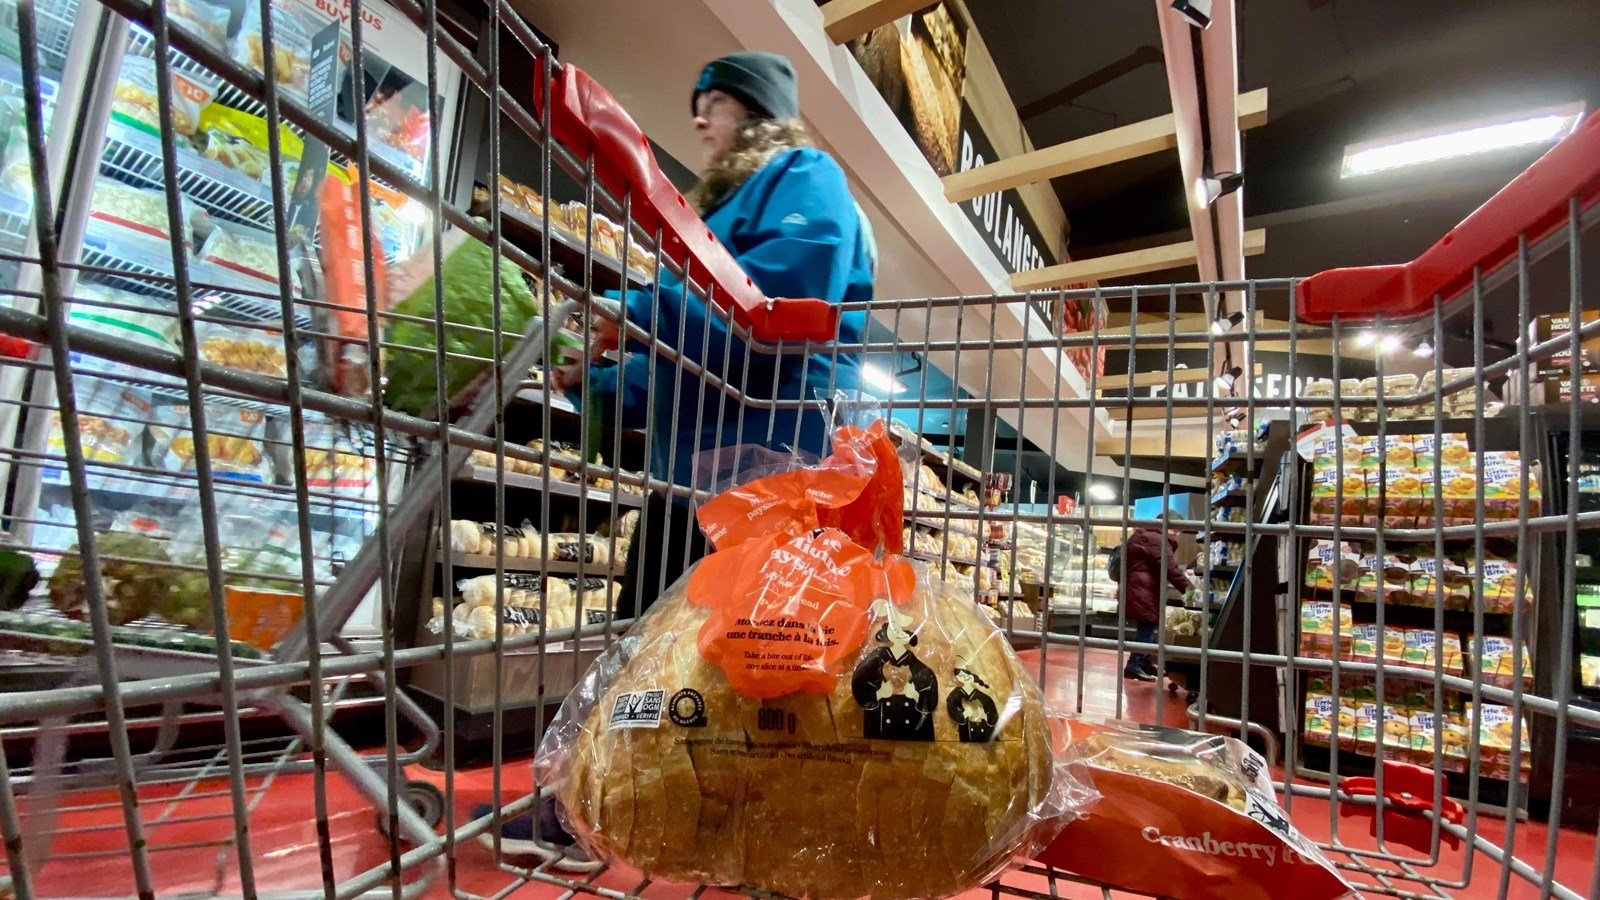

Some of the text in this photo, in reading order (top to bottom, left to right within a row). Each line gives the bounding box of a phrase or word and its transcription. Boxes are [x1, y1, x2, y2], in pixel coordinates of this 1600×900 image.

[315, 0, 350, 23] BUY
[777, 618, 805, 629] dans
[726, 630, 746, 639] une
[748, 630, 792, 641] tranche
[794, 632, 801, 642] à
[803, 633, 814, 645] la
[744, 651, 760, 659] Take
[760, 663, 777, 671] slice
[642, 703, 660, 711] OGM
[758, 708, 783, 731] 800
[1141, 825, 1277, 867] Cranberry
